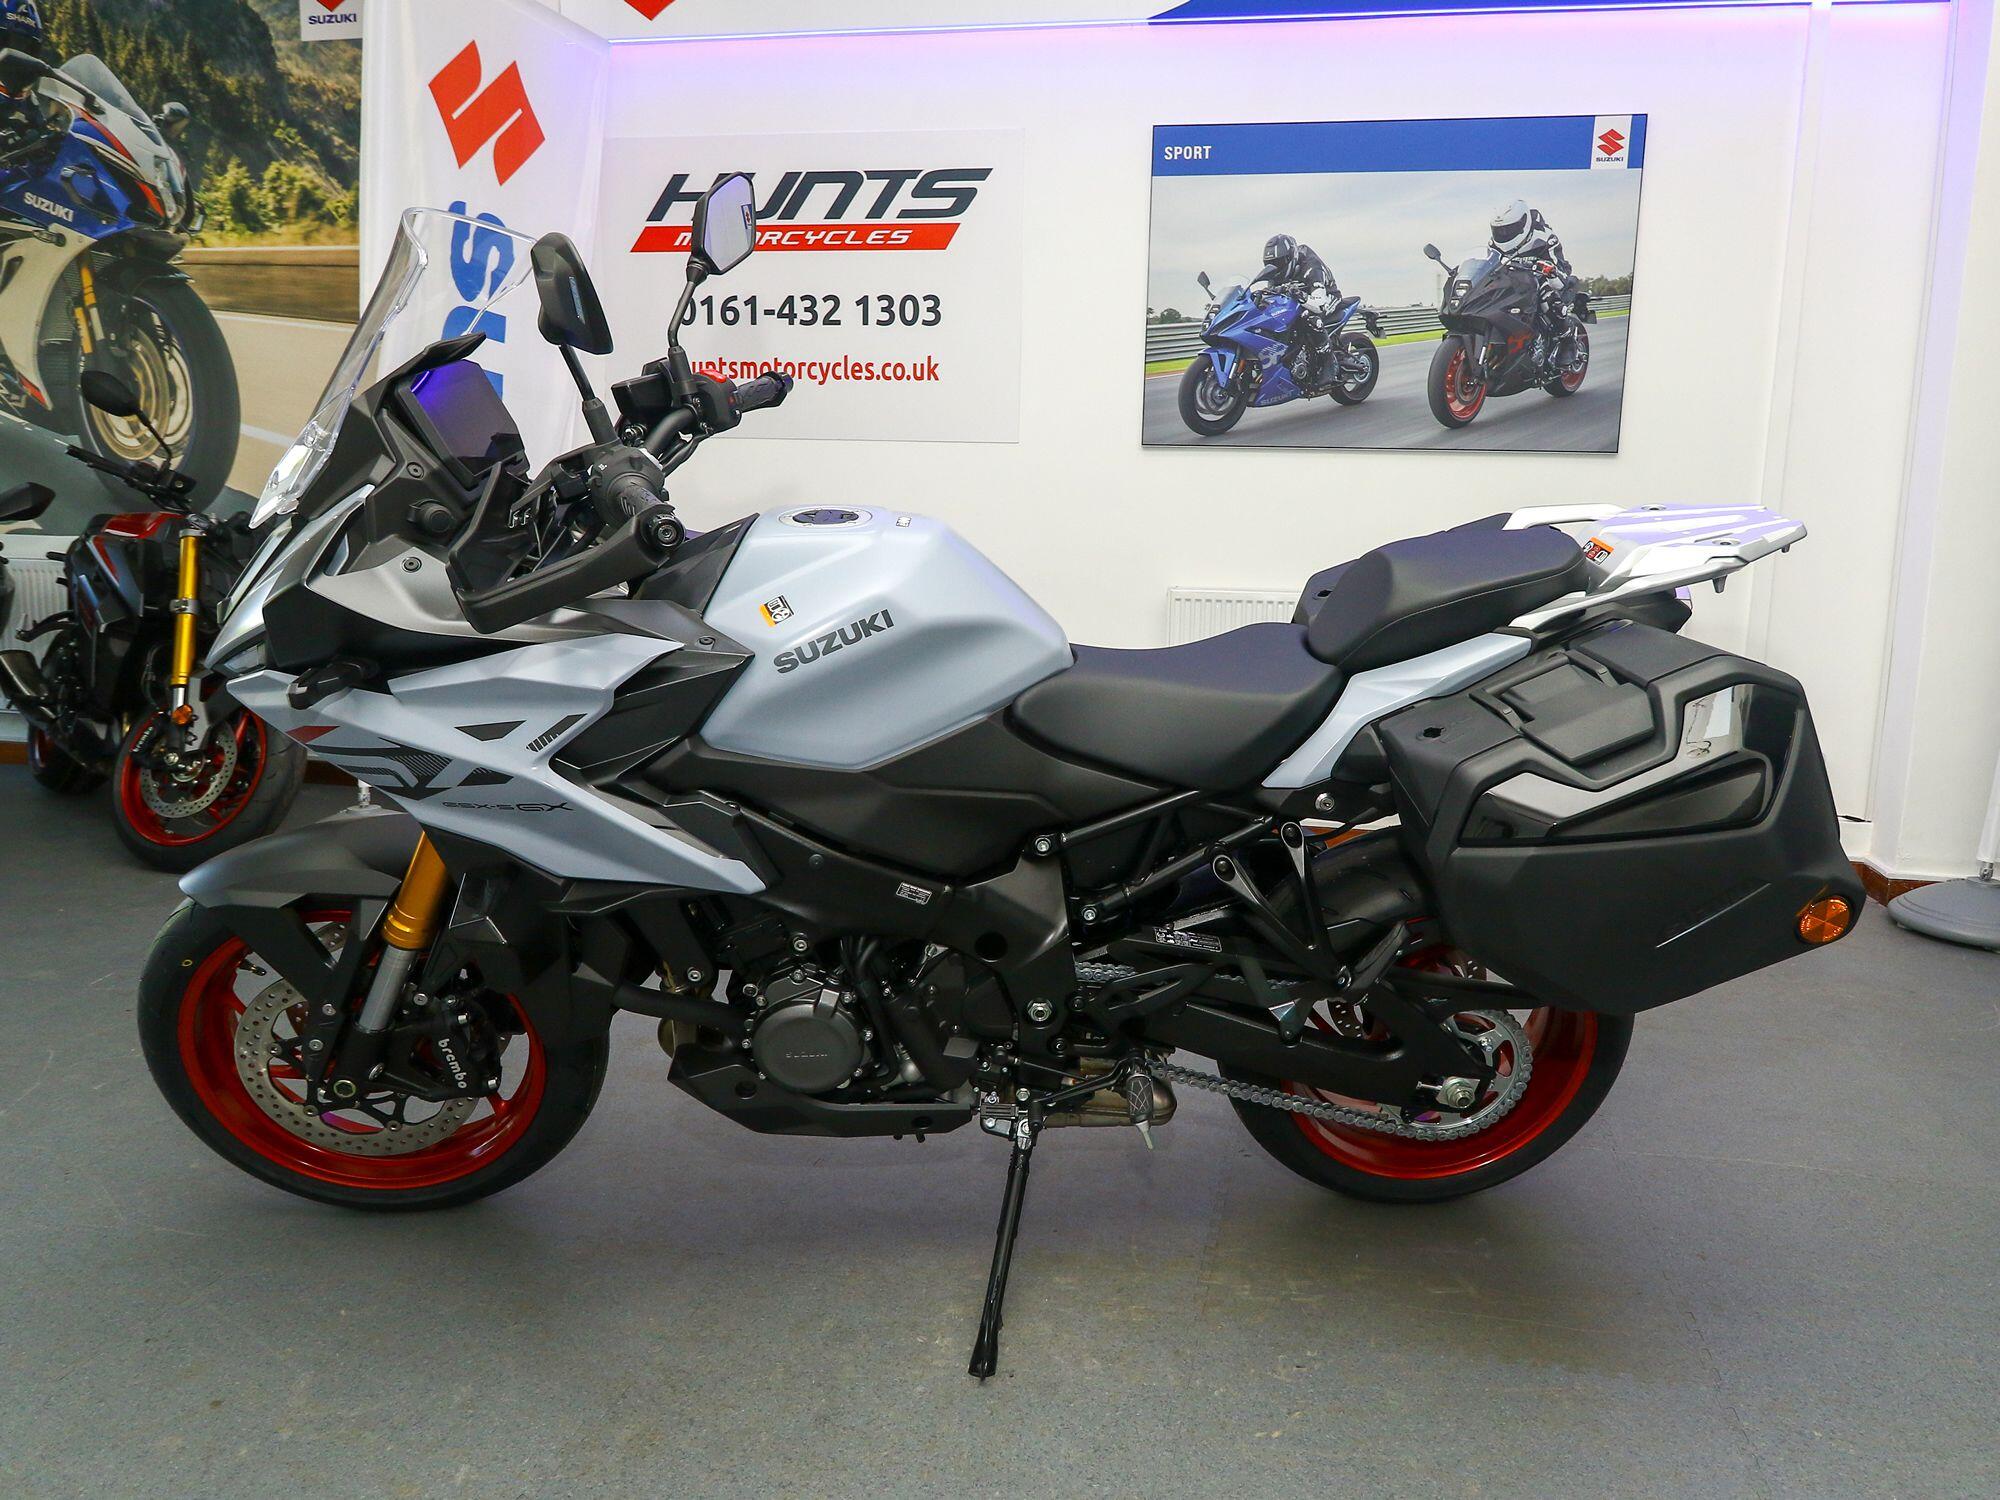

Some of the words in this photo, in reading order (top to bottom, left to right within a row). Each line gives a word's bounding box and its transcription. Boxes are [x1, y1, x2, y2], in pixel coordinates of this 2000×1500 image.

[308, 13, 357, 25] SUZUKI
[1164, 145, 1212, 160] SPORT
[24, 191, 74, 223] SUZUKI
[680, 294, 842, 326] 0161-432
[855, 294, 942, 326] 1303
[773, 608, 895, 674] SUZUKI
[438, 1038, 467, 1089] brembo
